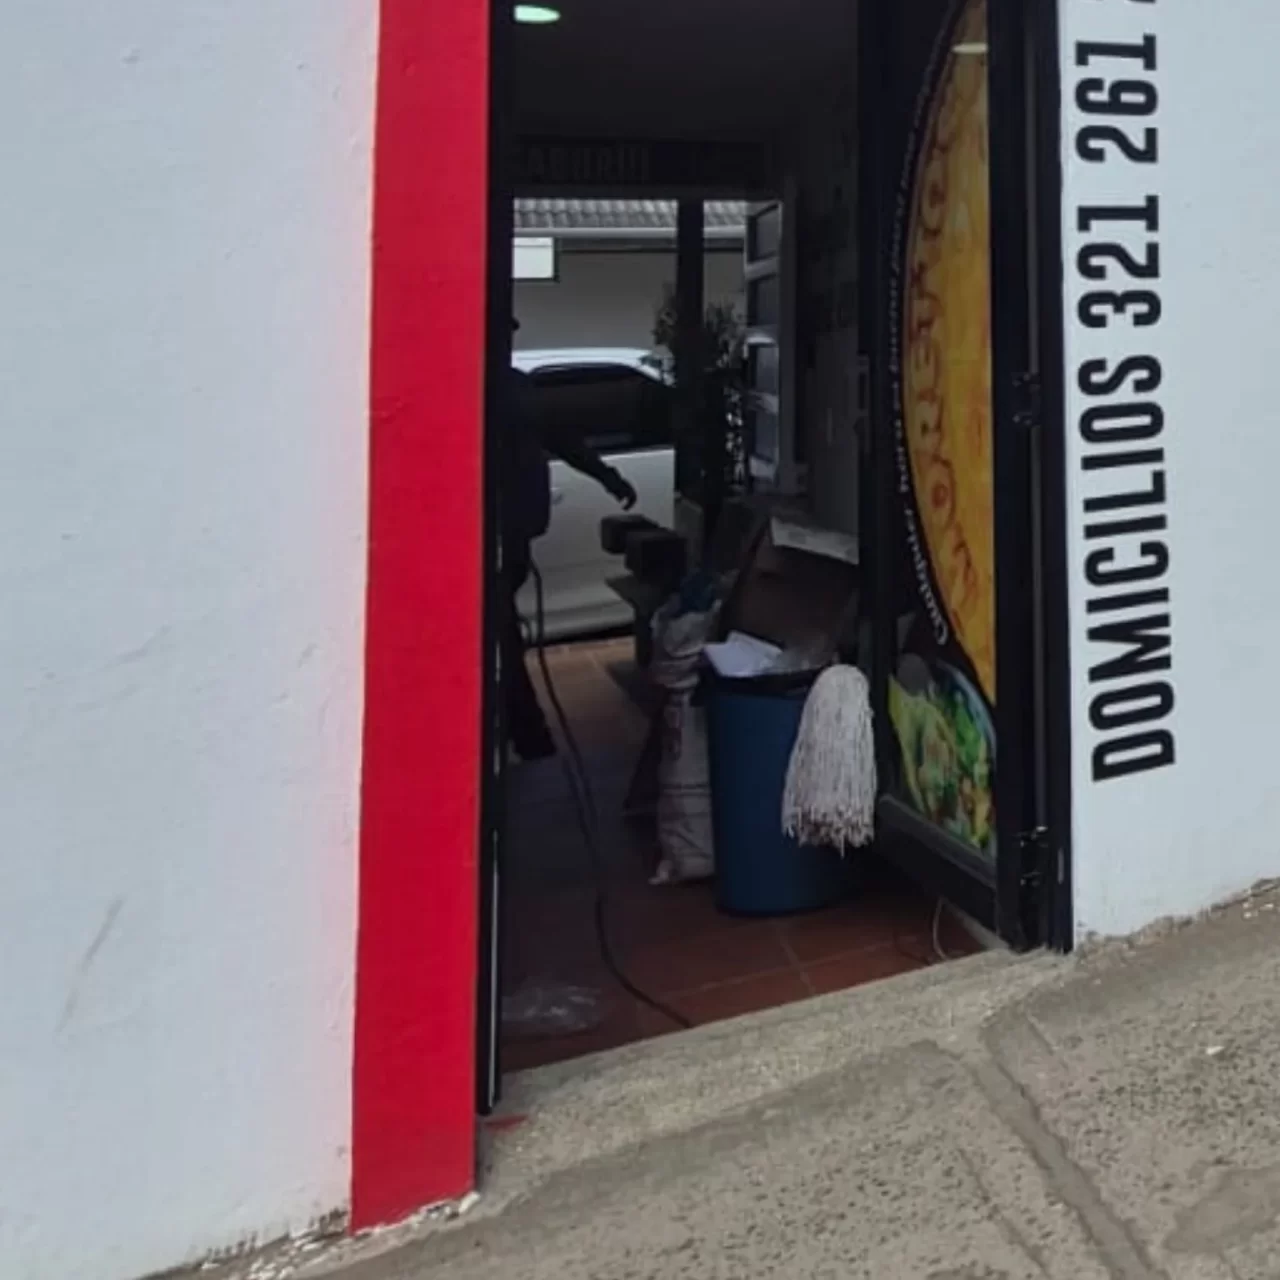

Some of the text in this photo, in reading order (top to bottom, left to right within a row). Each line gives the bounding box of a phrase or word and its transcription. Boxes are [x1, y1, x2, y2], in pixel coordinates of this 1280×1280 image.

[1073, 33, 1159, 164] 261
[1075, 194, 1162, 328] 321
[1076, 354, 1177, 783] DOMICILIOS
